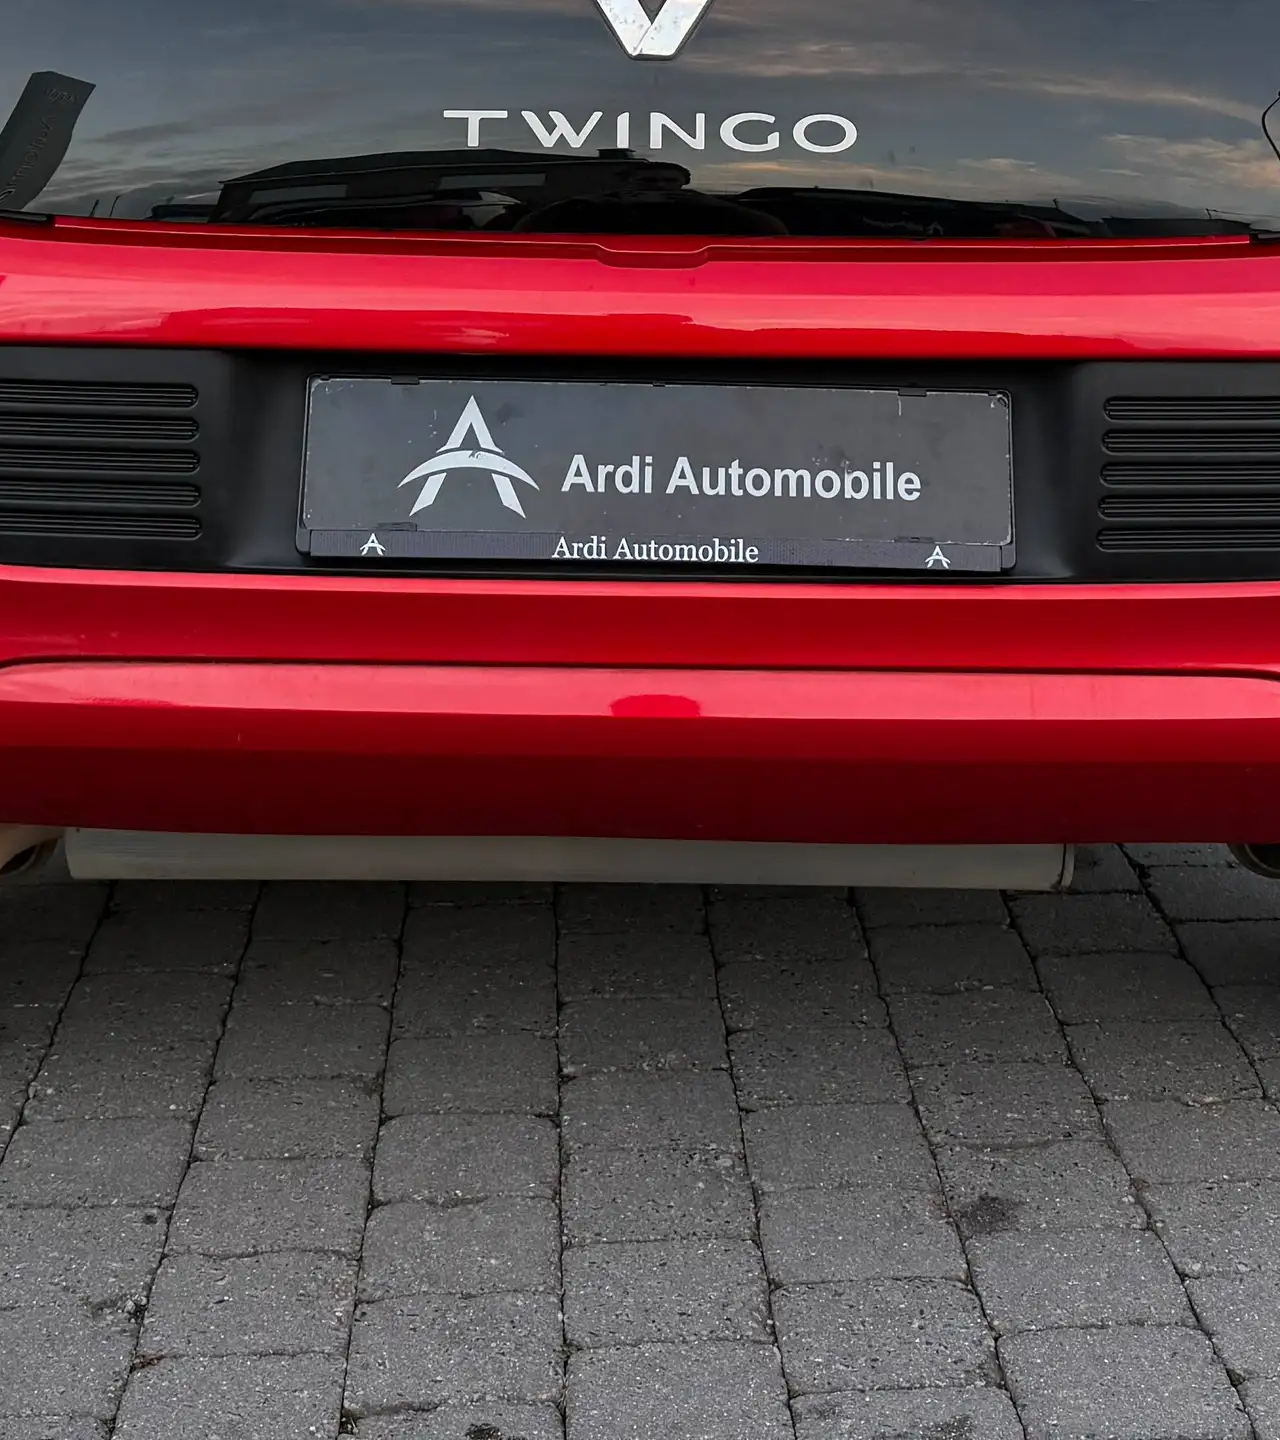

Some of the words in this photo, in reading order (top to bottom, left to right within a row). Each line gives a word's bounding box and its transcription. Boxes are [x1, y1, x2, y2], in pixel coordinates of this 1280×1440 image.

[442, 109, 859, 153] TWINGO
[560, 453, 654, 495] Ardi
[665, 456, 923, 501] Automobile
[550, 534, 608, 561] Ardi
[614, 535, 761, 565] Automobile
